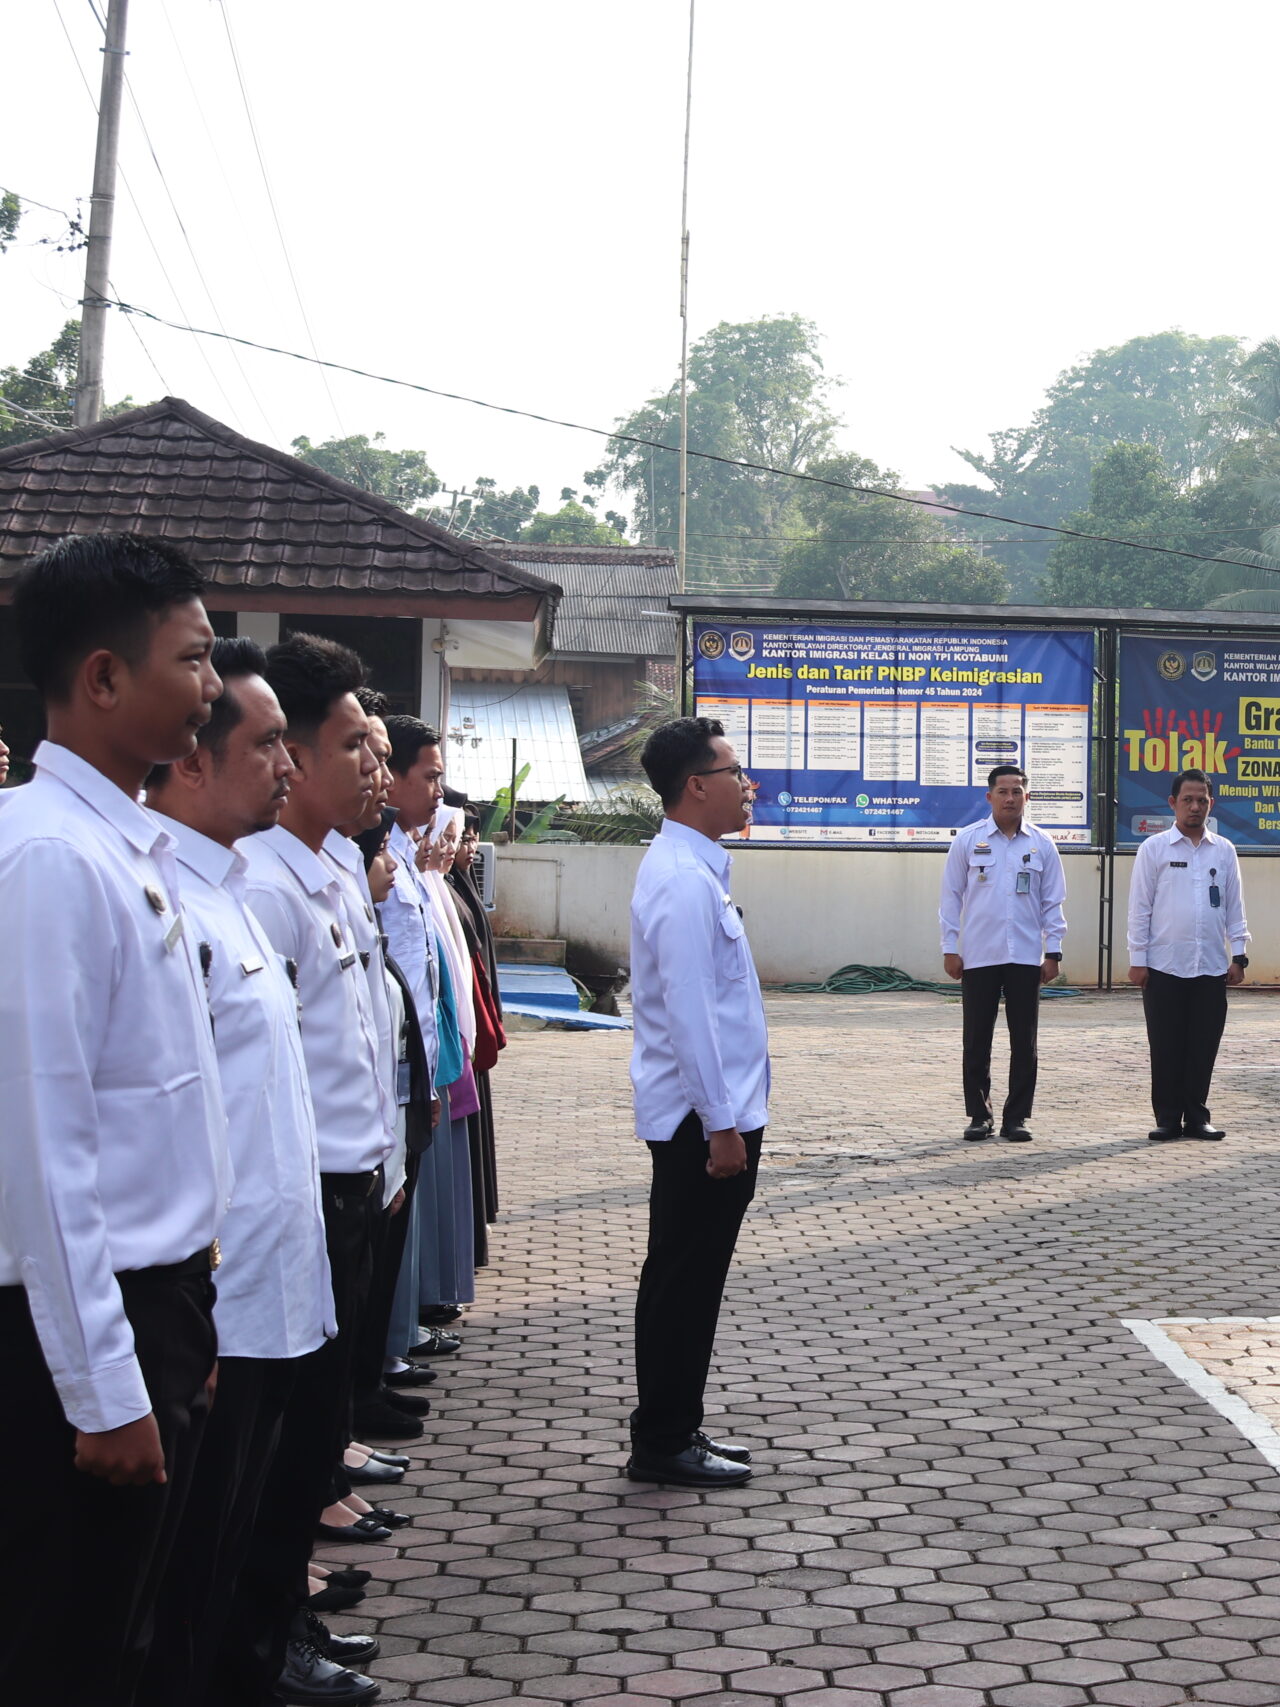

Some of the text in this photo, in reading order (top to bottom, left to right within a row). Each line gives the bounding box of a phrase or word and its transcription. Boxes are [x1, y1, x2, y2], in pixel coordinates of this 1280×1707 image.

[763, 634, 815, 642] KEMENTERIAN
[865, 636, 932, 645] PEMASYARAKATAN
[827, 643, 872, 651] DIREKTORAT
[873, 644, 910, 652] JENDERAL
[762, 649, 1008, 663] KANTOR IMIGRASI KELAS II NON TPI KOTABUMI
[1224, 653, 1277, 661] KEMENTERIAN
[1224, 662, 1254, 670] KANTOR
[747, 663, 1043, 686] Jenis dan Tarif PNBP Keimigrasian
[1223, 672, 1267, 682] KANTOR
[806, 685, 983, 697] Peraturan Pemerintah Nomor 45 Tahun 2024
[1244, 738, 1274, 750] Bantu
[1124, 729, 1229, 774] Tolak
[1219, 784, 1259, 798] Menuju
[793, 796, 847, 804] TELEPON/FAX
[872, 797, 920, 805] WHATSAPP
[1254, 801, 1274, 814] Dan
